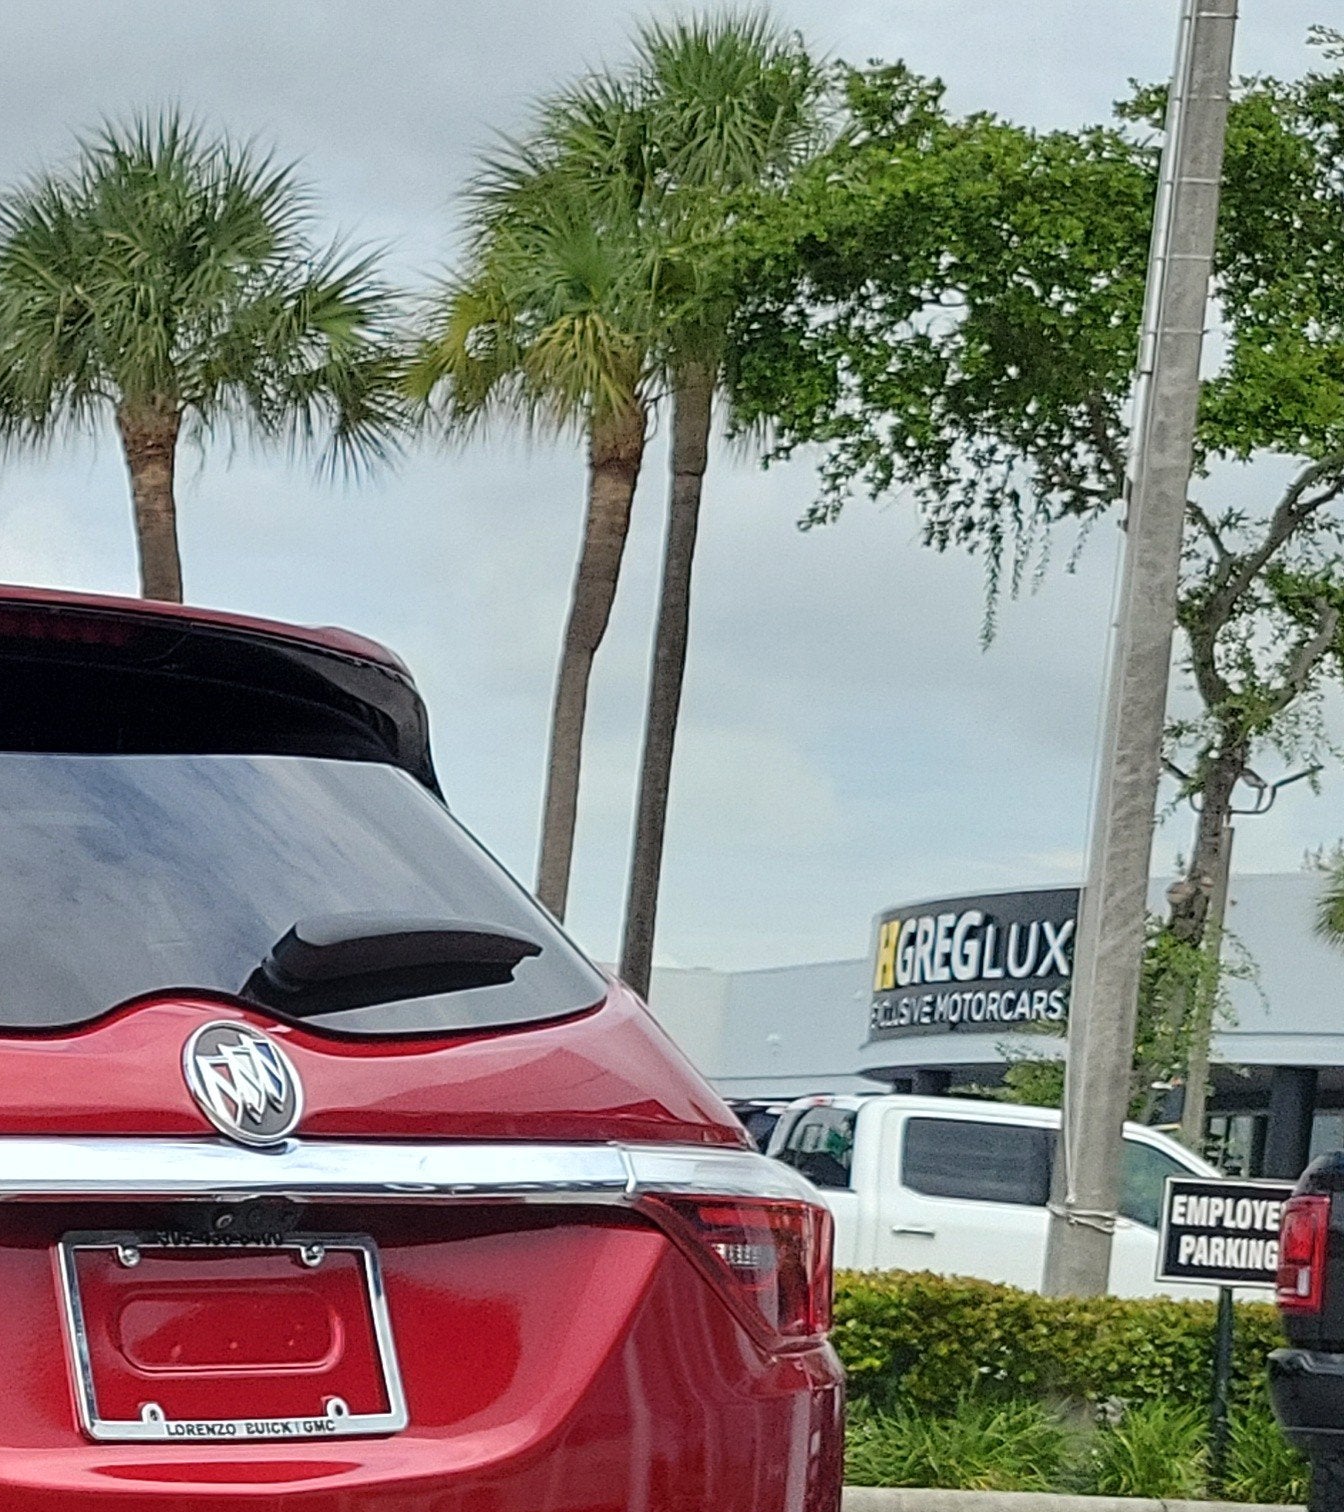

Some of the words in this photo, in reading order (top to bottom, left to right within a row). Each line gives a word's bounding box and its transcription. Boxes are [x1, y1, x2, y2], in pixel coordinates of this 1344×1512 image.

[933, 988, 1066, 1025] MOTORCARS
[1171, 1194, 1286, 1232] EMPLOYE
[1178, 1234, 1279, 1271] PARKING
[165, 1423, 237, 1437] LORENZO
[302, 1419, 336, 1434] GMC
